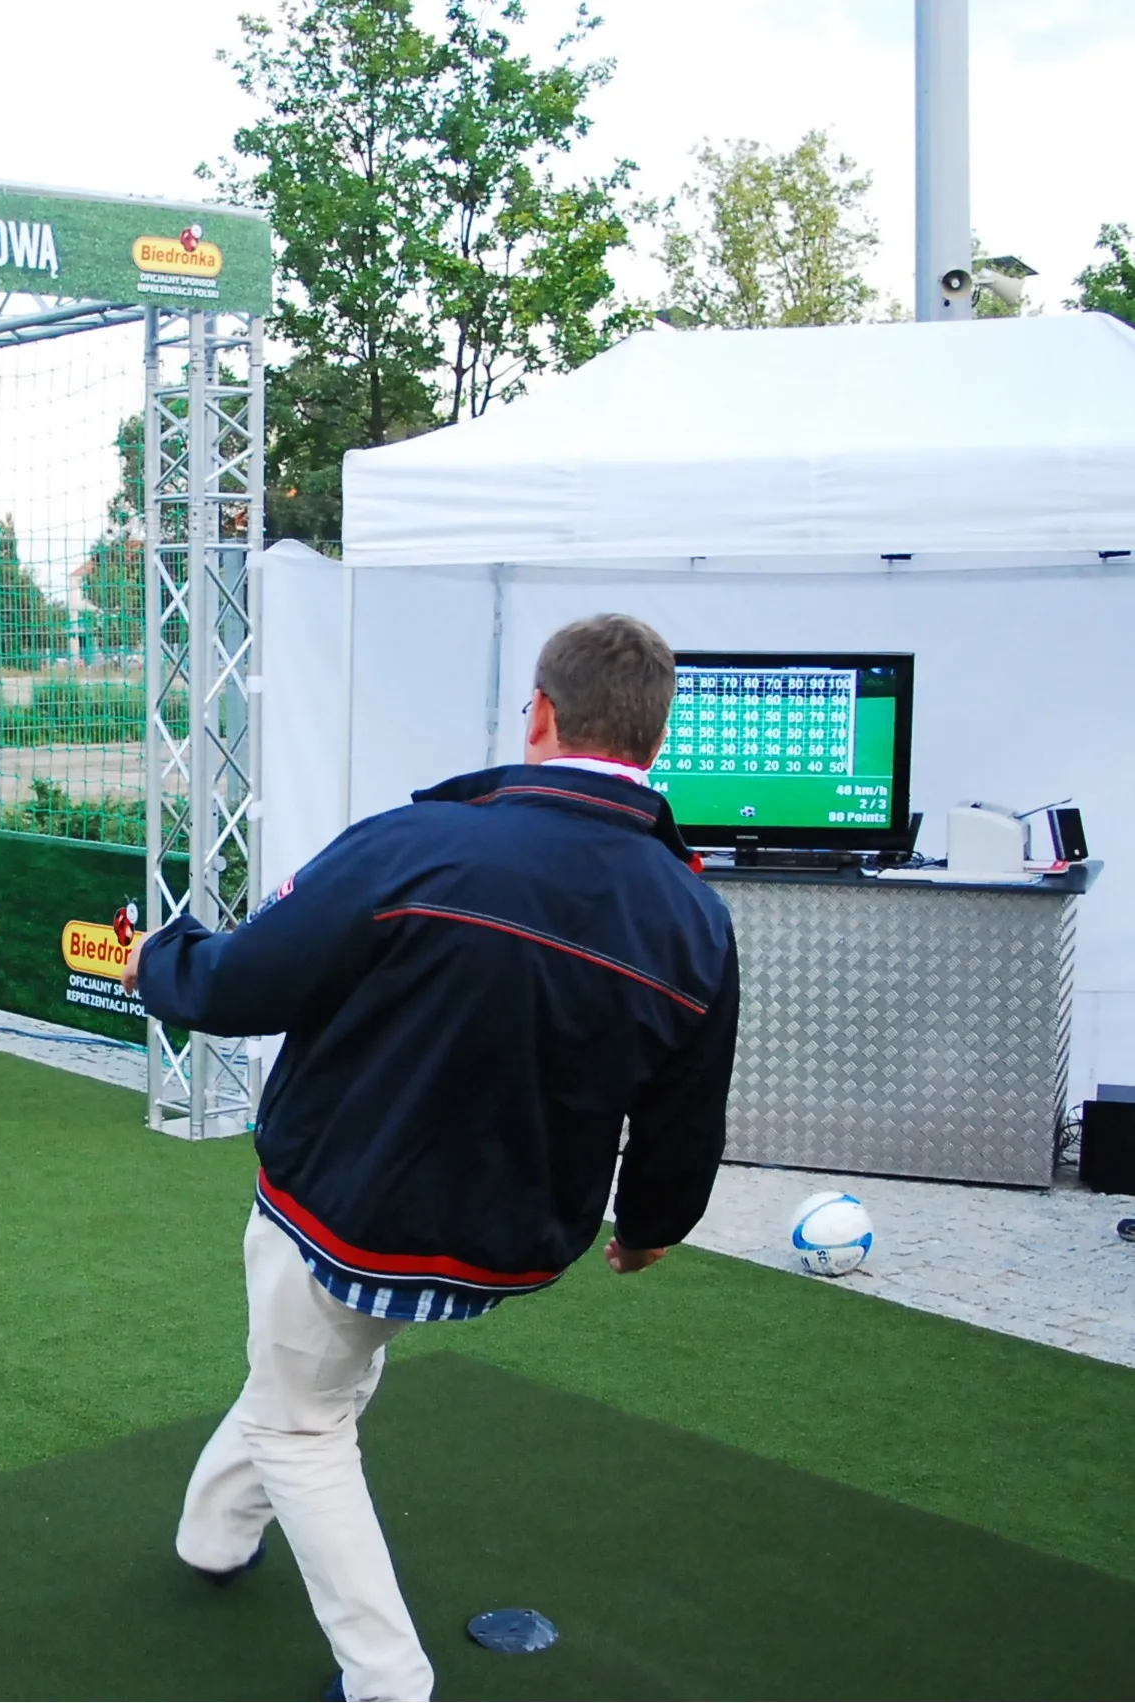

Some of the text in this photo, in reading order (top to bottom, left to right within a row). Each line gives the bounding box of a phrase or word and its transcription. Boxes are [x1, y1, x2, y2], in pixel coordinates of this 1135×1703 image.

[141, 244, 215, 267] Biedronka
[678, 677, 850, 689] 90 80 70 60 70 80 90 100
[656, 759, 844, 772] 50 40 30 20 10 20 30 40 50
[855, 785, 888, 796] km/h
[859, 799, 867, 809] 2
[878, 799, 886, 809] 3
[847, 812, 886, 822] Points
[69, 975, 112, 994] OFICJALNY
[67, 989, 128, 1013] REPREZENTACJI
[130, 1002, 145, 1017] POL
